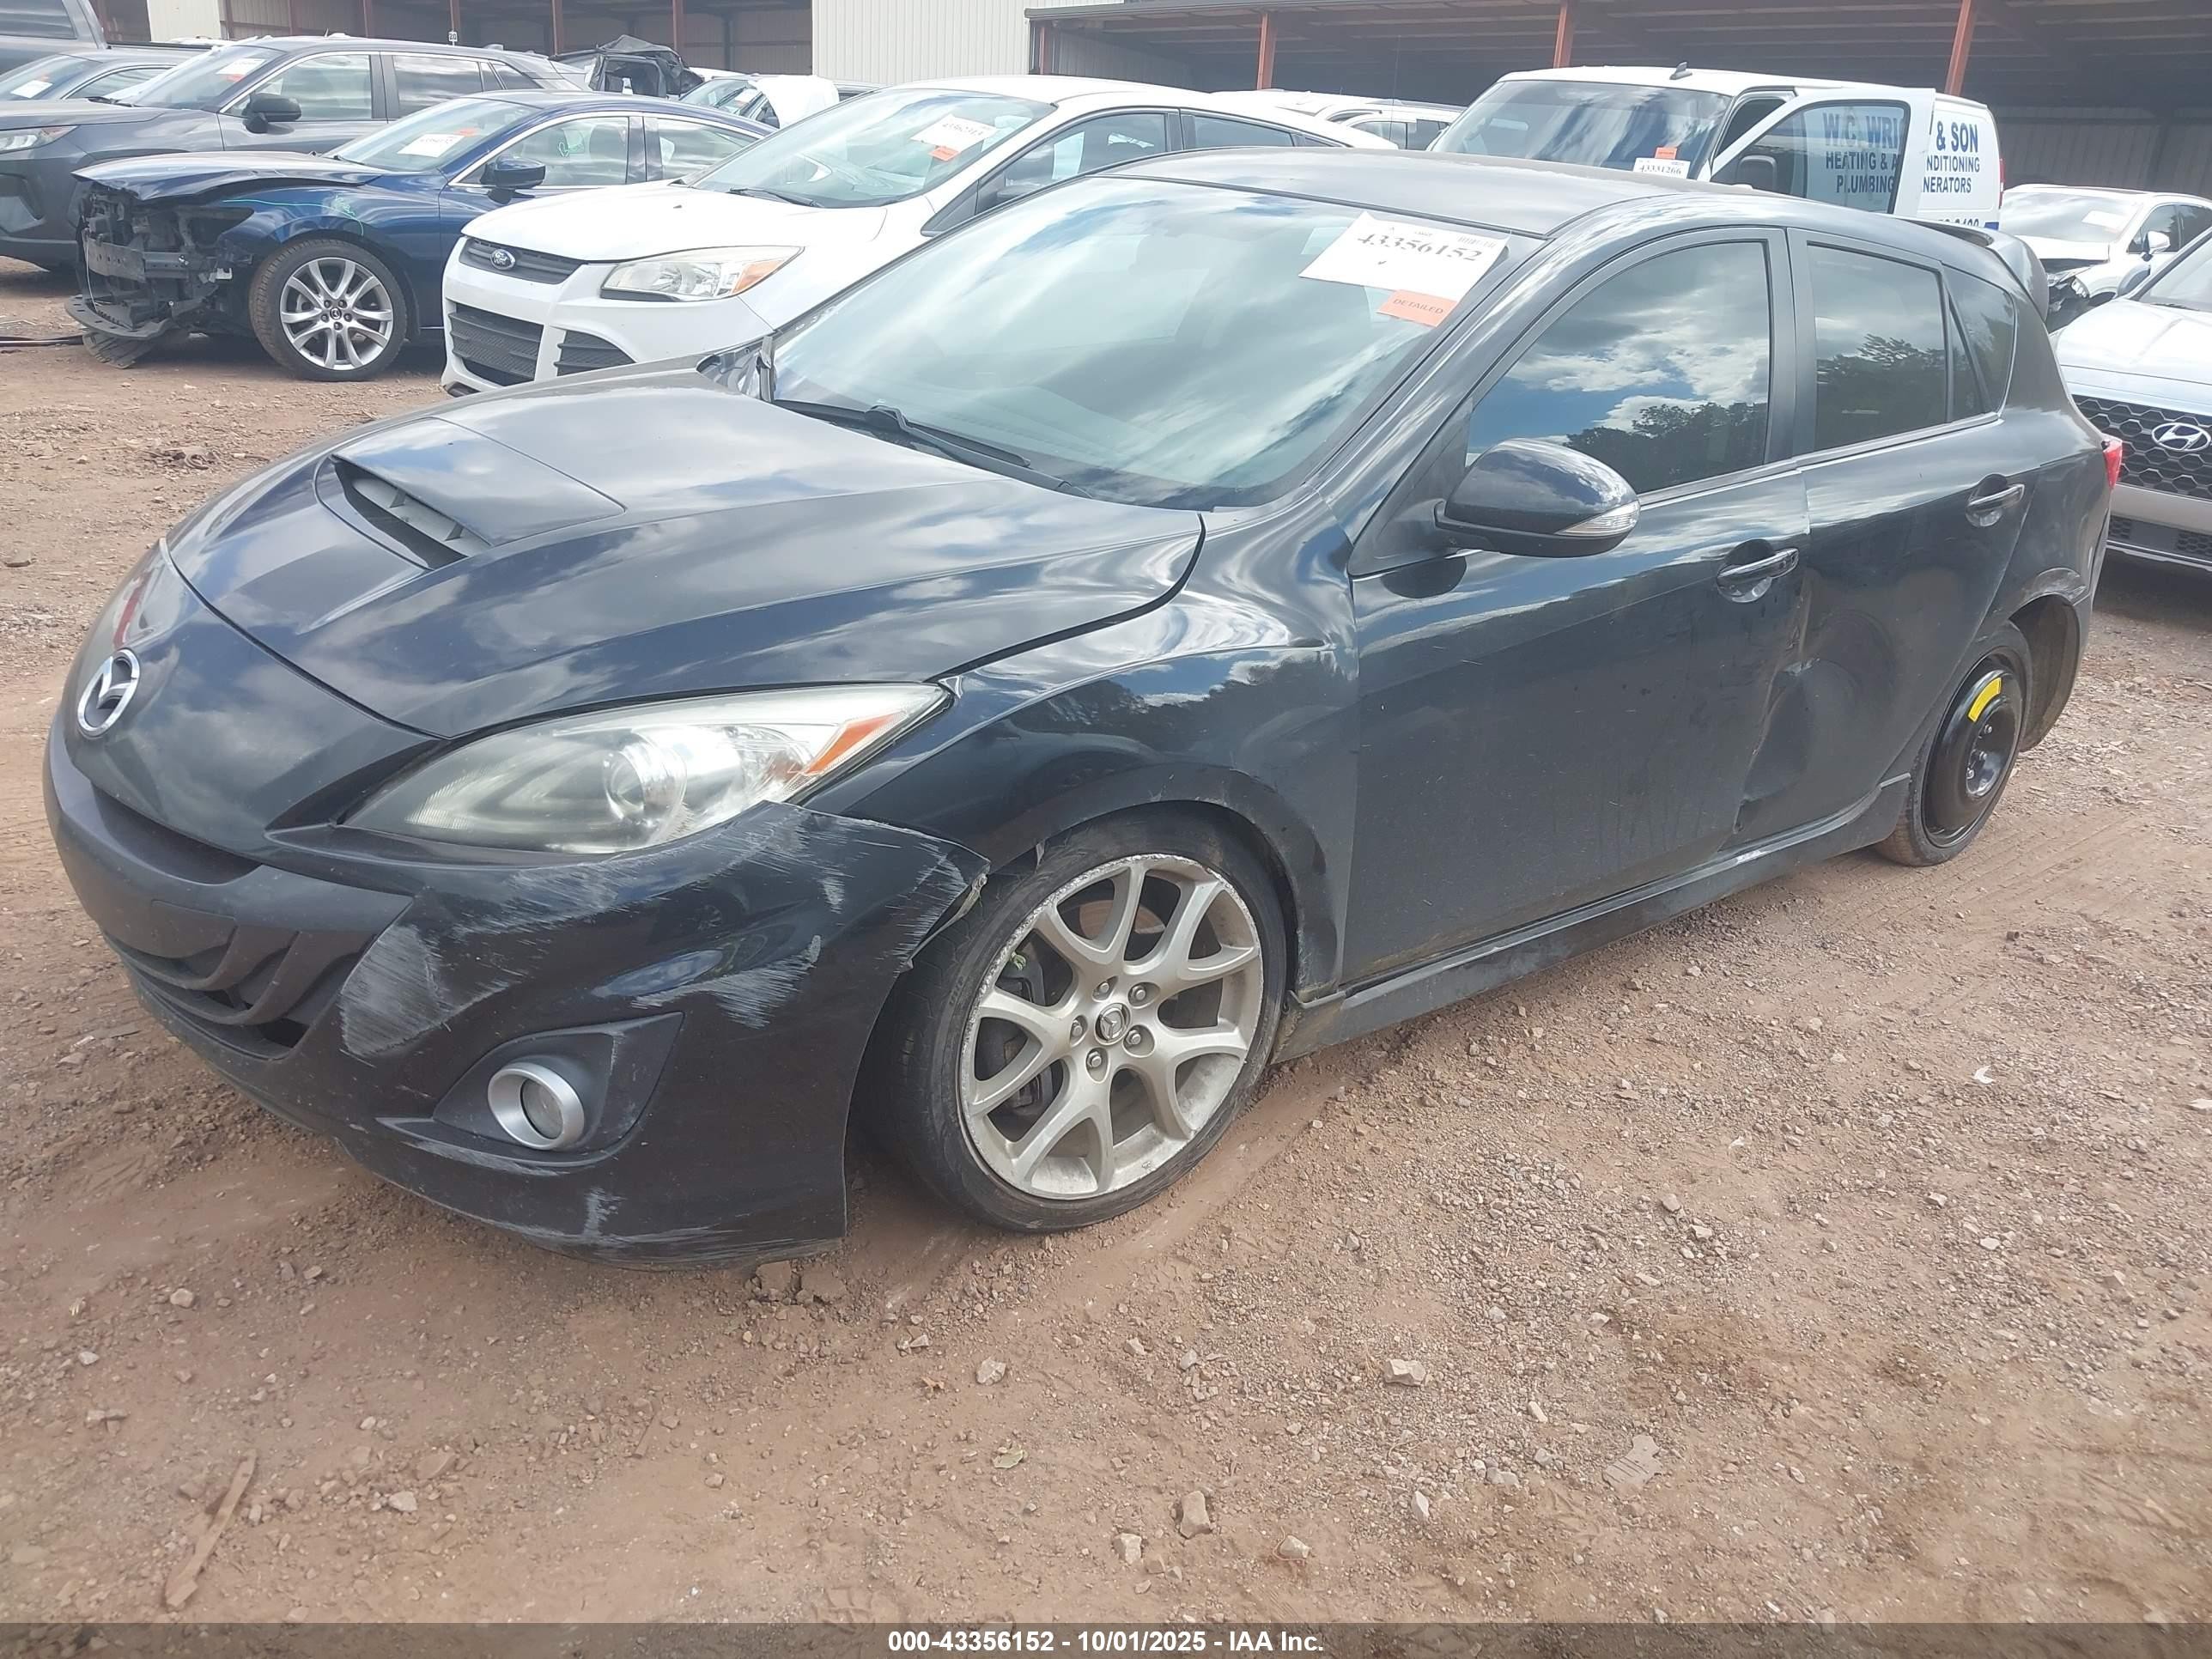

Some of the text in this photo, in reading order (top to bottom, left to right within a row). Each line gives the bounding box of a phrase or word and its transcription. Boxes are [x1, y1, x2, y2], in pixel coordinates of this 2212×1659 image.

[1936, 120, 1946, 151] &
[1951, 121, 1978, 153] SON
[1826, 151, 1876, 170] HEATING
[1881, 153, 1887, 170] &
[1926, 155, 1980, 173] NDITIONING
[1836, 174, 1972, 193] PLUMBING NERATORS
[1357, 233, 1483, 261] 43356152
[1393, 298, 1443, 314] DETAILED
